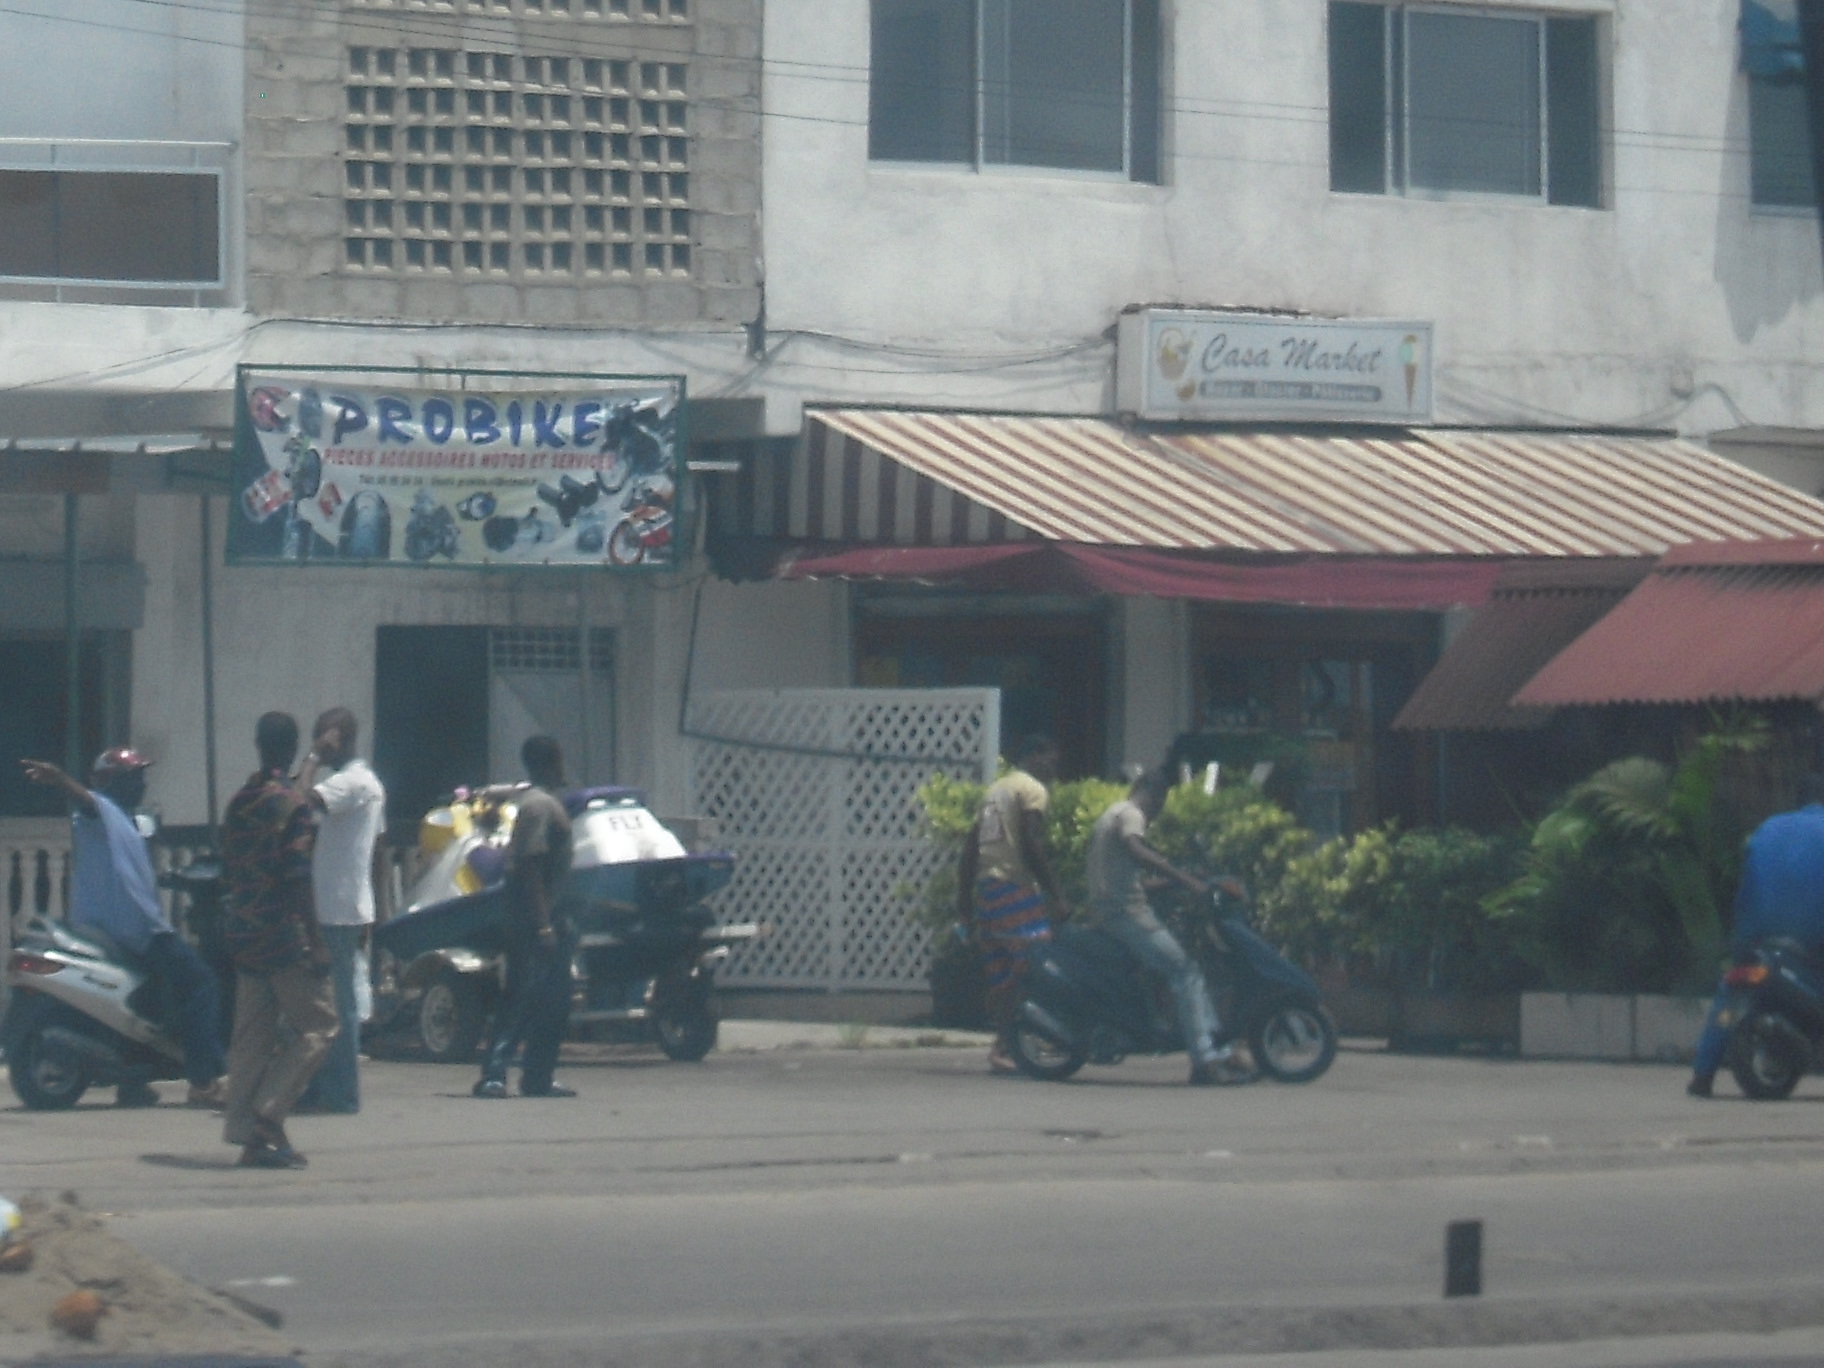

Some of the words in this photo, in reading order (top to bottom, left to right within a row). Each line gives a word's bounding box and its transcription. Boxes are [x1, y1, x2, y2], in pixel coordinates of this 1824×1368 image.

[1200, 333, 1271, 374] Casa
[1280, 336, 1384, 373] Market
[328, 394, 603, 449] PROBIKE
